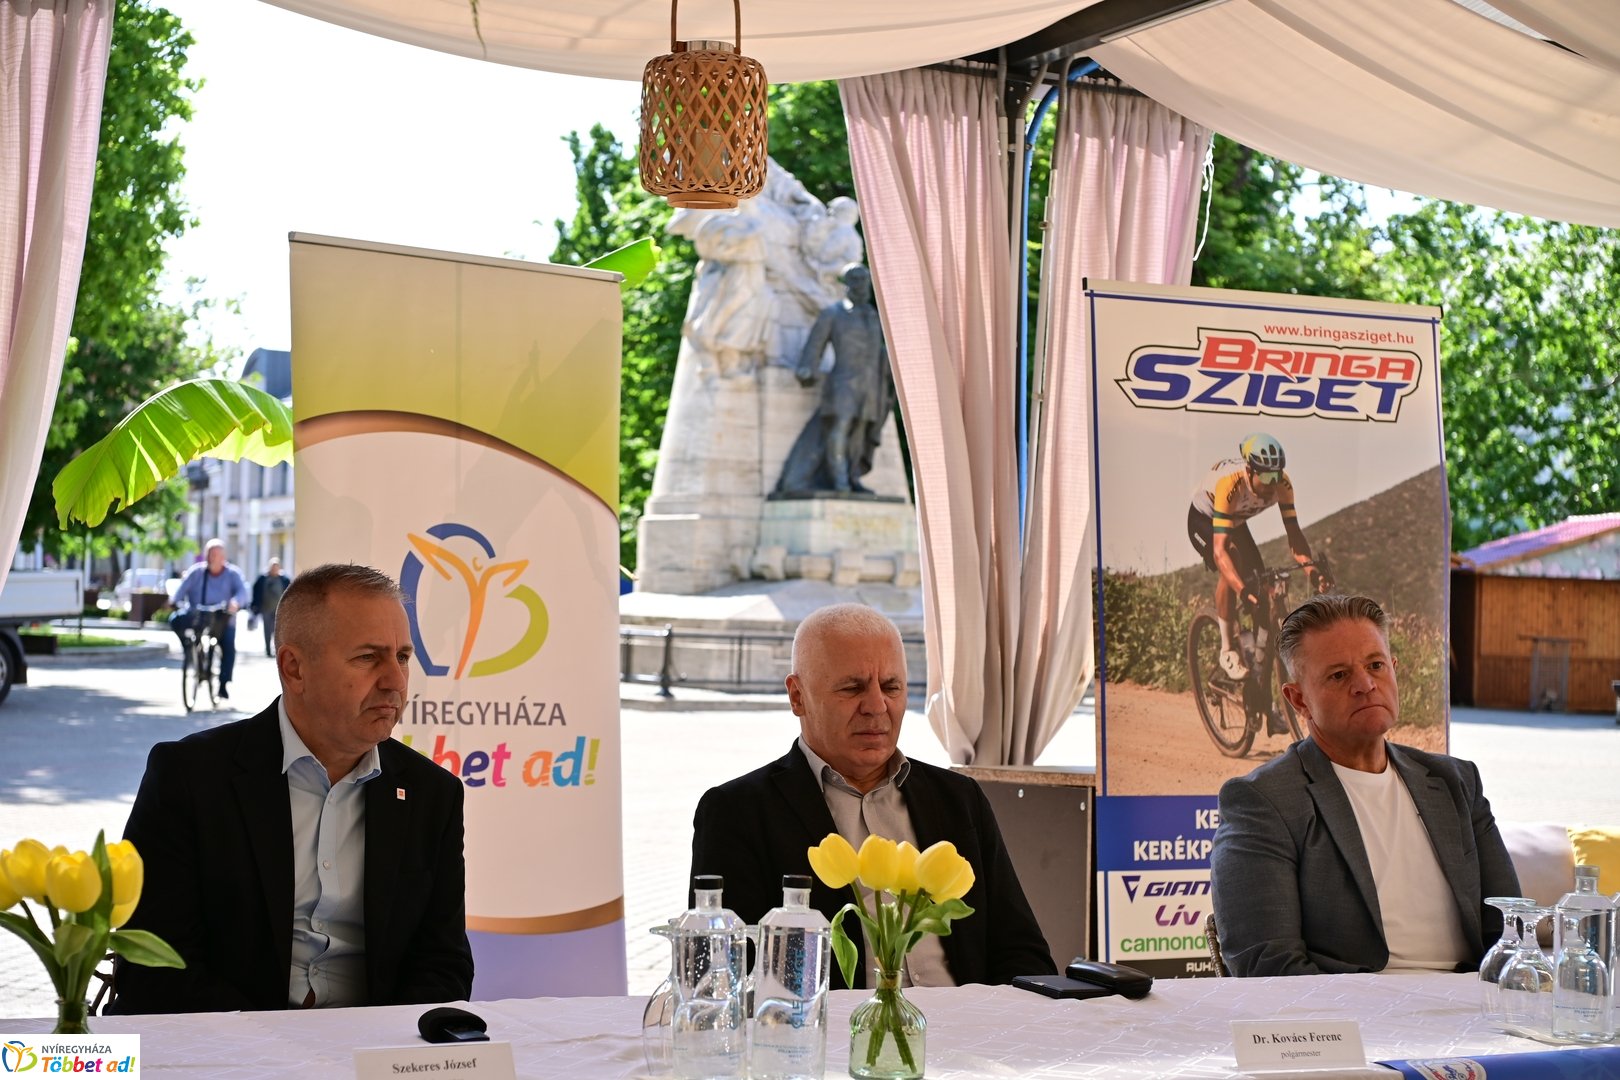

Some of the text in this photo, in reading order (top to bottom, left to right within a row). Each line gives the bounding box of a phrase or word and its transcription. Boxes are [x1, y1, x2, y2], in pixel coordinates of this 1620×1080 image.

[1264, 324, 1414, 344] www.bringasziget.hu
[1200, 336, 1415, 381] BRINGA
[1130, 353, 1410, 414] SZIGET
[522, 736, 600, 788] ad!
[1195, 809, 1220, 830] KE
[1133, 834, 1213, 861] KERÉKP
[1143, 881, 1211, 897] GIAN
[1155, 904, 1201, 926] Liv
[1120, 935, 1210, 952] cannond
[1252, 1032, 1342, 1044] Dr. Kovács Ferenc
[1281, 1050, 1321, 1059] polgármester
[392, 1058, 477, 1074] Szekeres József
